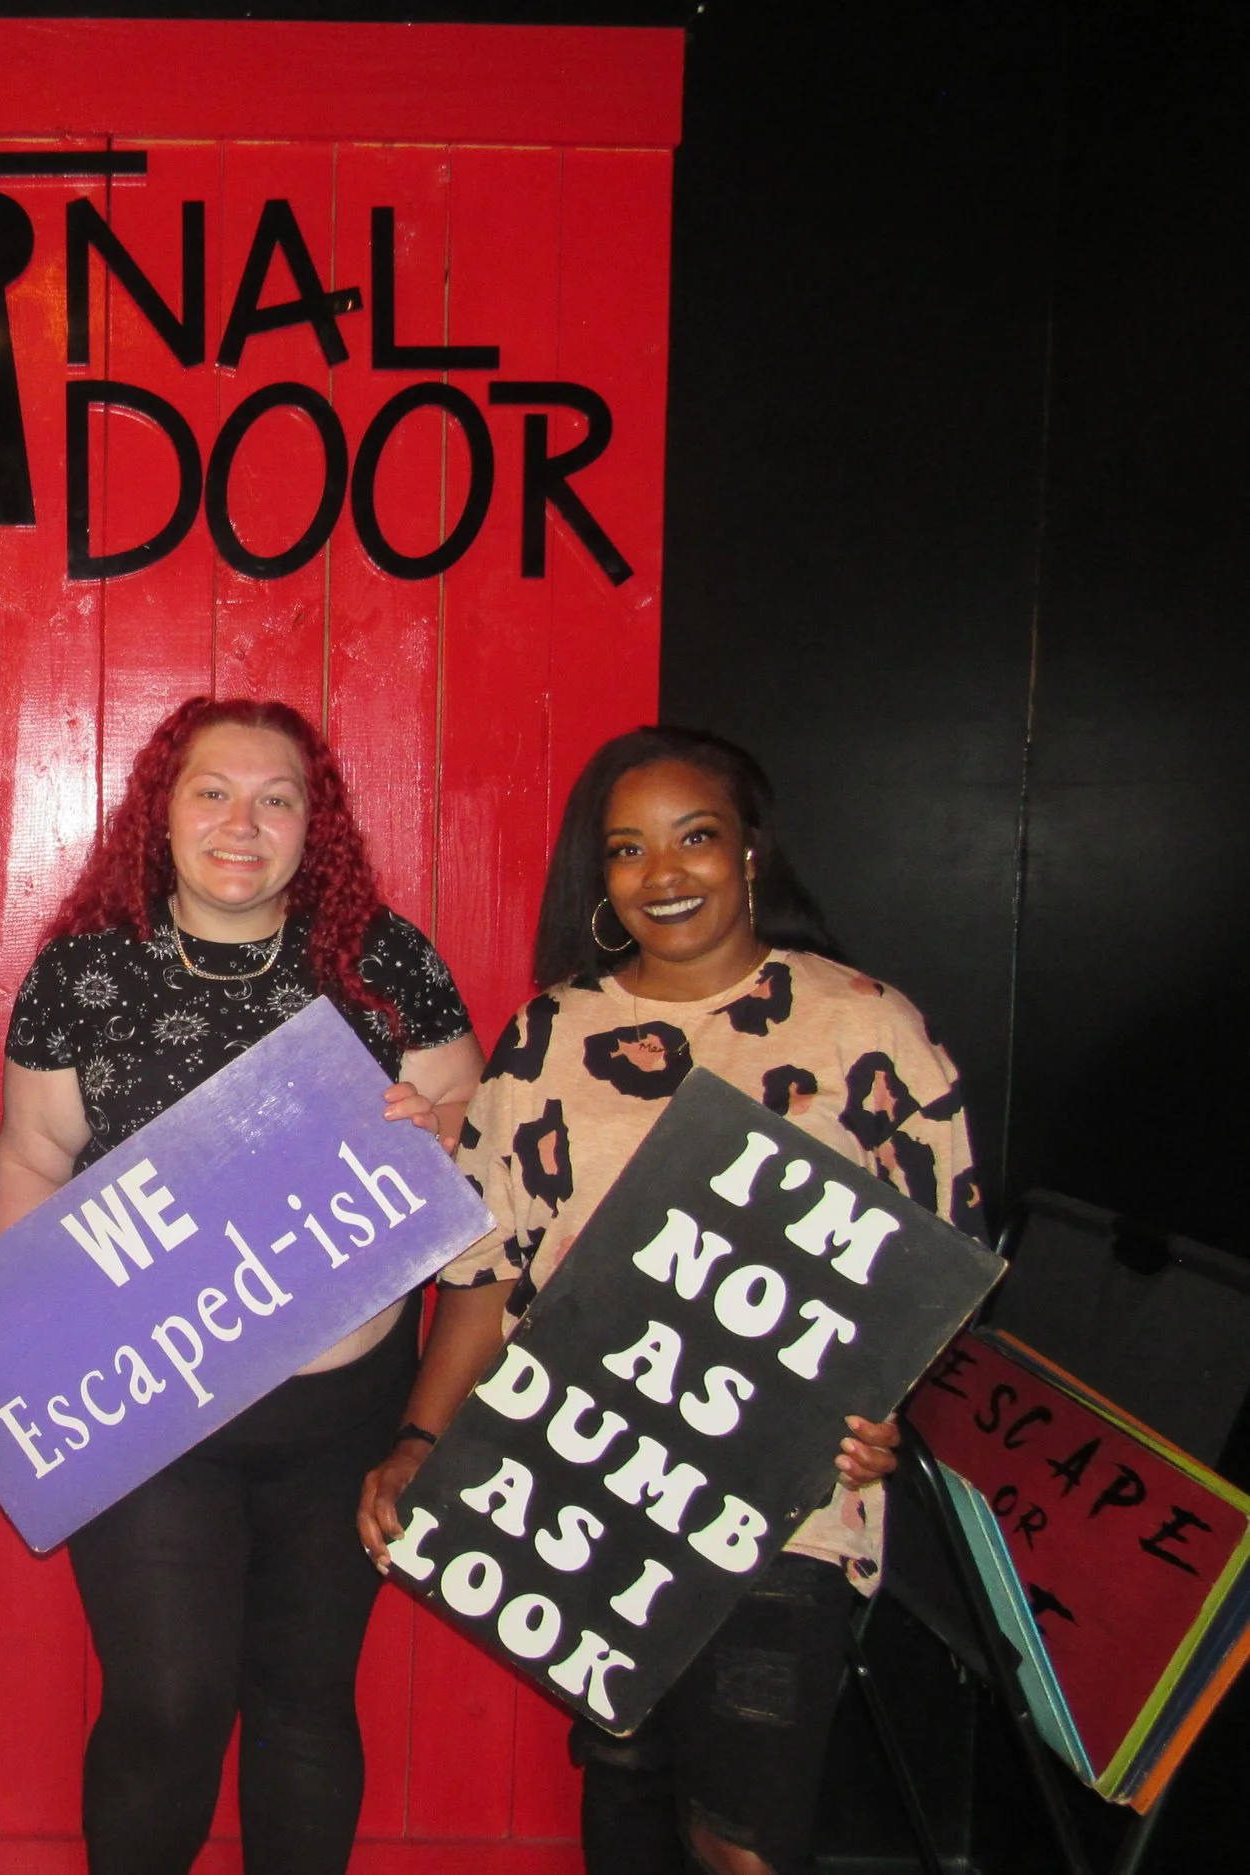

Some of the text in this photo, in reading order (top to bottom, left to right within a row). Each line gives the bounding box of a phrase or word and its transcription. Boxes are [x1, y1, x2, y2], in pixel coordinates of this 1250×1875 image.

[66, 380, 634, 588] DOOR
[60, 1158, 199, 1288] WE
[709, 1131, 900, 1285] I'M
[602, 1320, 755, 1436] AS
[631, 1208, 855, 1380] NOT
[459, 1457, 675, 1626] AS I
[474, 1343, 769, 1574] DUMB
[928, 1349, 1214, 1578] ESCAPE
[992, 1484, 1048, 1550] OR
[385, 1506, 636, 1720] LOOK
